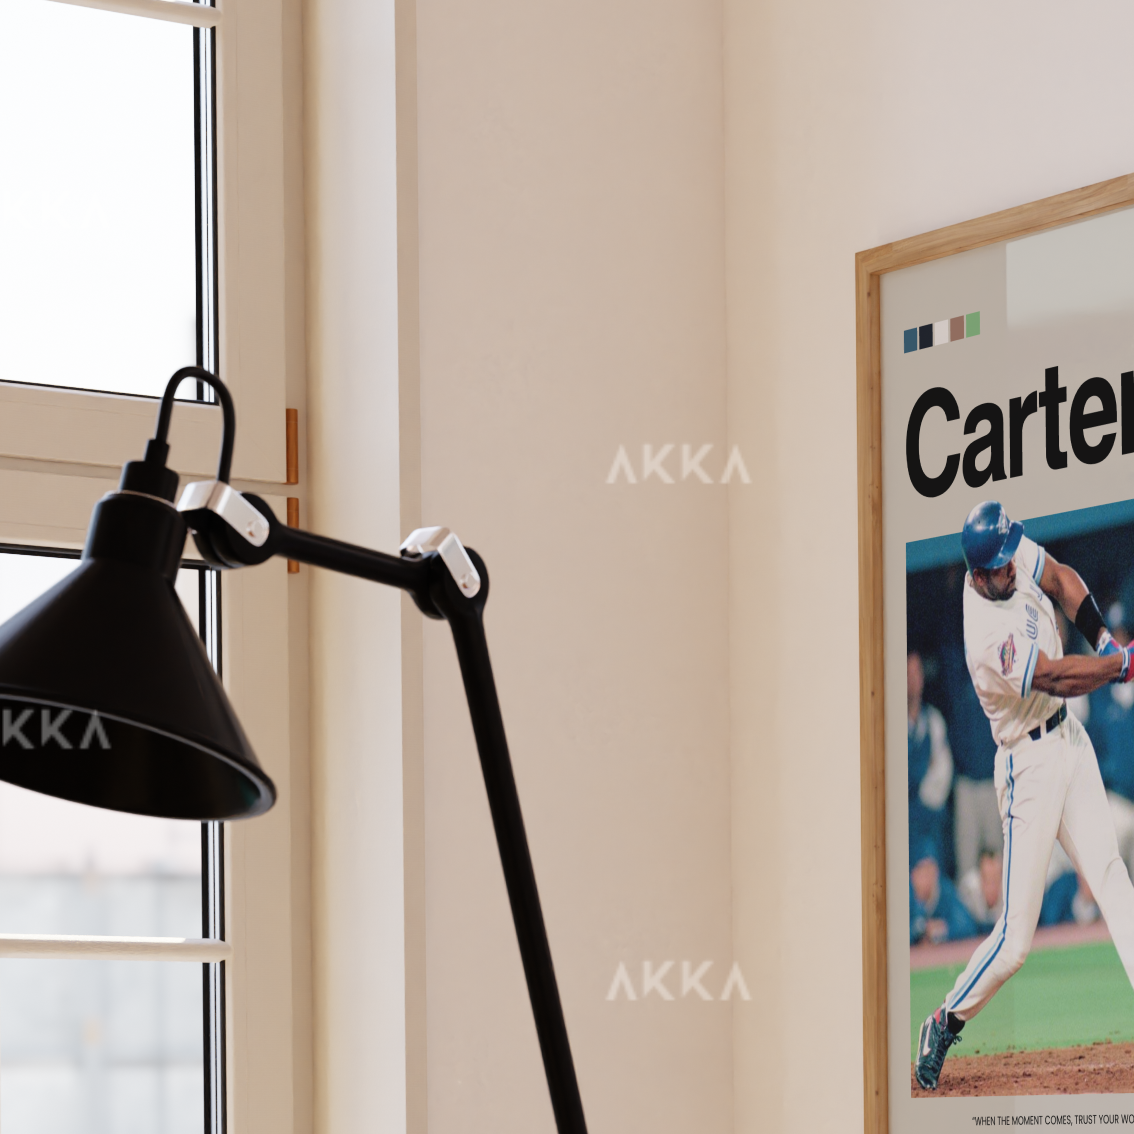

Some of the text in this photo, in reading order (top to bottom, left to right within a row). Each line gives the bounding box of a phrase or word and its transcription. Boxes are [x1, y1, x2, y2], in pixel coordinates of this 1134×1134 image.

[998, 1116, 1010, 1125] THE
[1011, 1116, 1042, 1125] MOMENT
[1044, 1115, 1072, 1126] COMES,
[1075, 1115, 1097, 1124] TRUST
[1098, 1114, 1120, 1124] YOUR
